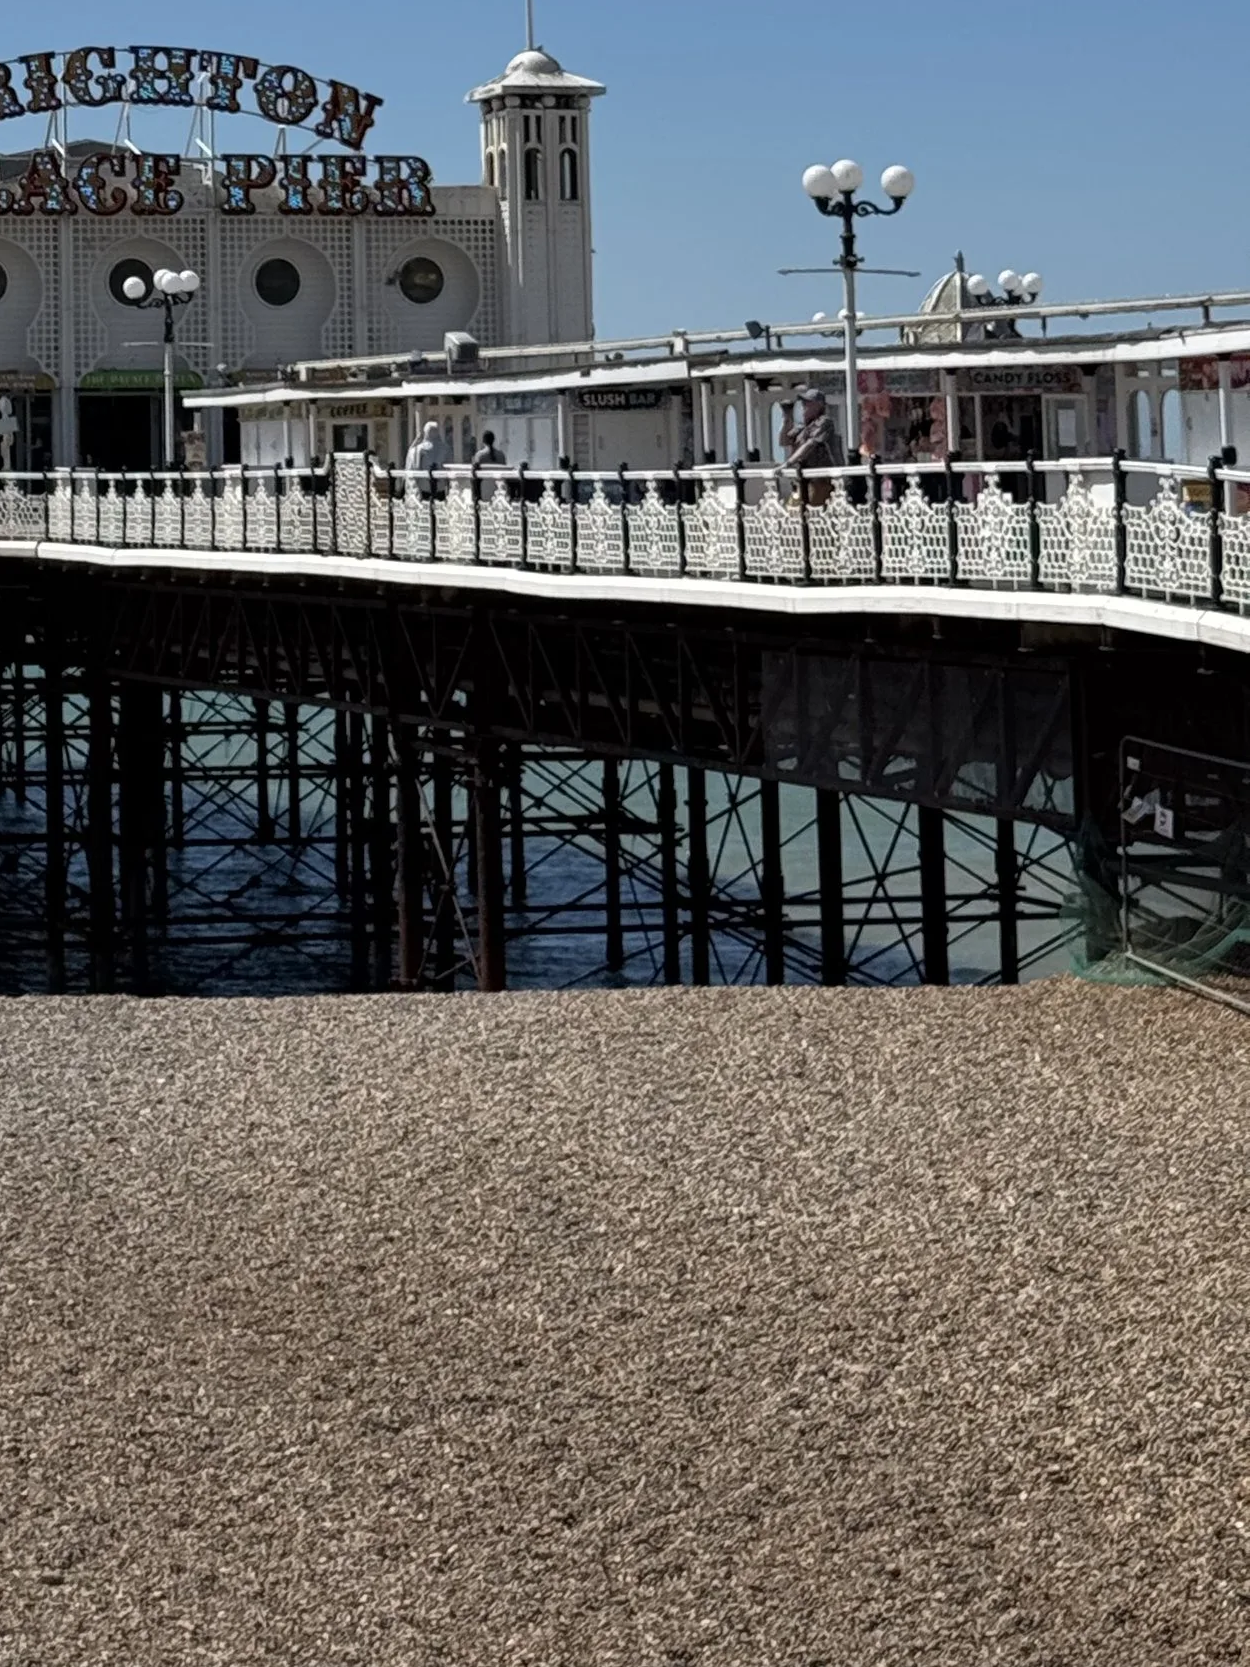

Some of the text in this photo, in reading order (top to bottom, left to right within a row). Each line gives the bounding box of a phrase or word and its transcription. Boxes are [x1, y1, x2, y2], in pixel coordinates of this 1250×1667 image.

[221, 153, 436, 217] PIER
[973, 371, 1071, 384] CANDY FLOSS
[582, 392, 656, 407] SLUSH BAR
[330, 403, 368, 418] COFFEE
